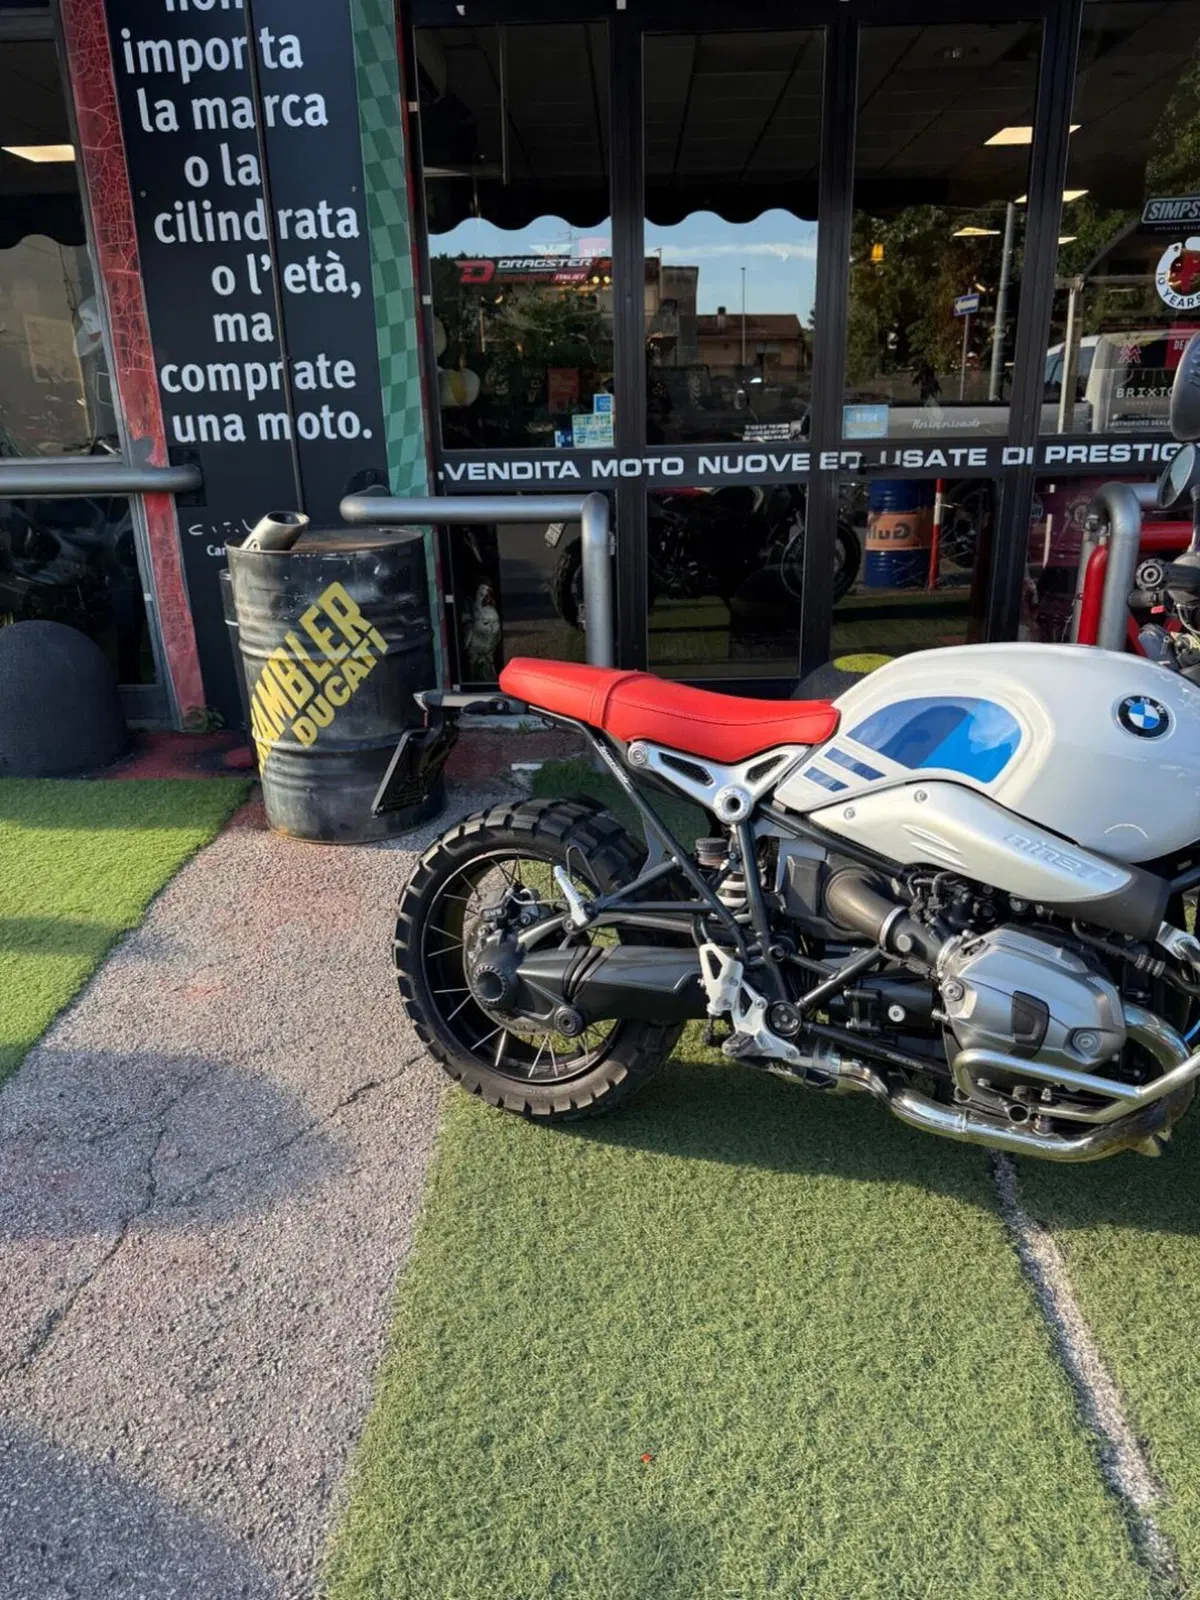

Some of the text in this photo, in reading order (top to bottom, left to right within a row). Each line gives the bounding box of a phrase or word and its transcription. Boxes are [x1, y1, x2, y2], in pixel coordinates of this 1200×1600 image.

[120, 27, 304, 84] importa
[136, 87, 329, 132] la marca
[184, 142, 261, 187] o la
[153, 198, 360, 244] cilindrata
[1148, 201, 1200, 219] SIMPS
[211, 264, 236, 296] o
[497, 258, 593, 269] DRAGSTER
[212, 312, 275, 343] ma
[160, 353, 356, 401] comprate
[1115, 387, 1174, 398] BRIXTO
[172, 404, 373, 443] una moto.
[443, 442, 1200, 481] VENDITA MOTO NUOVE ED USATE DI PRESTIG
[291, 628, 388, 748] DUCATI
[1124, 696, 1166, 715] BMW
